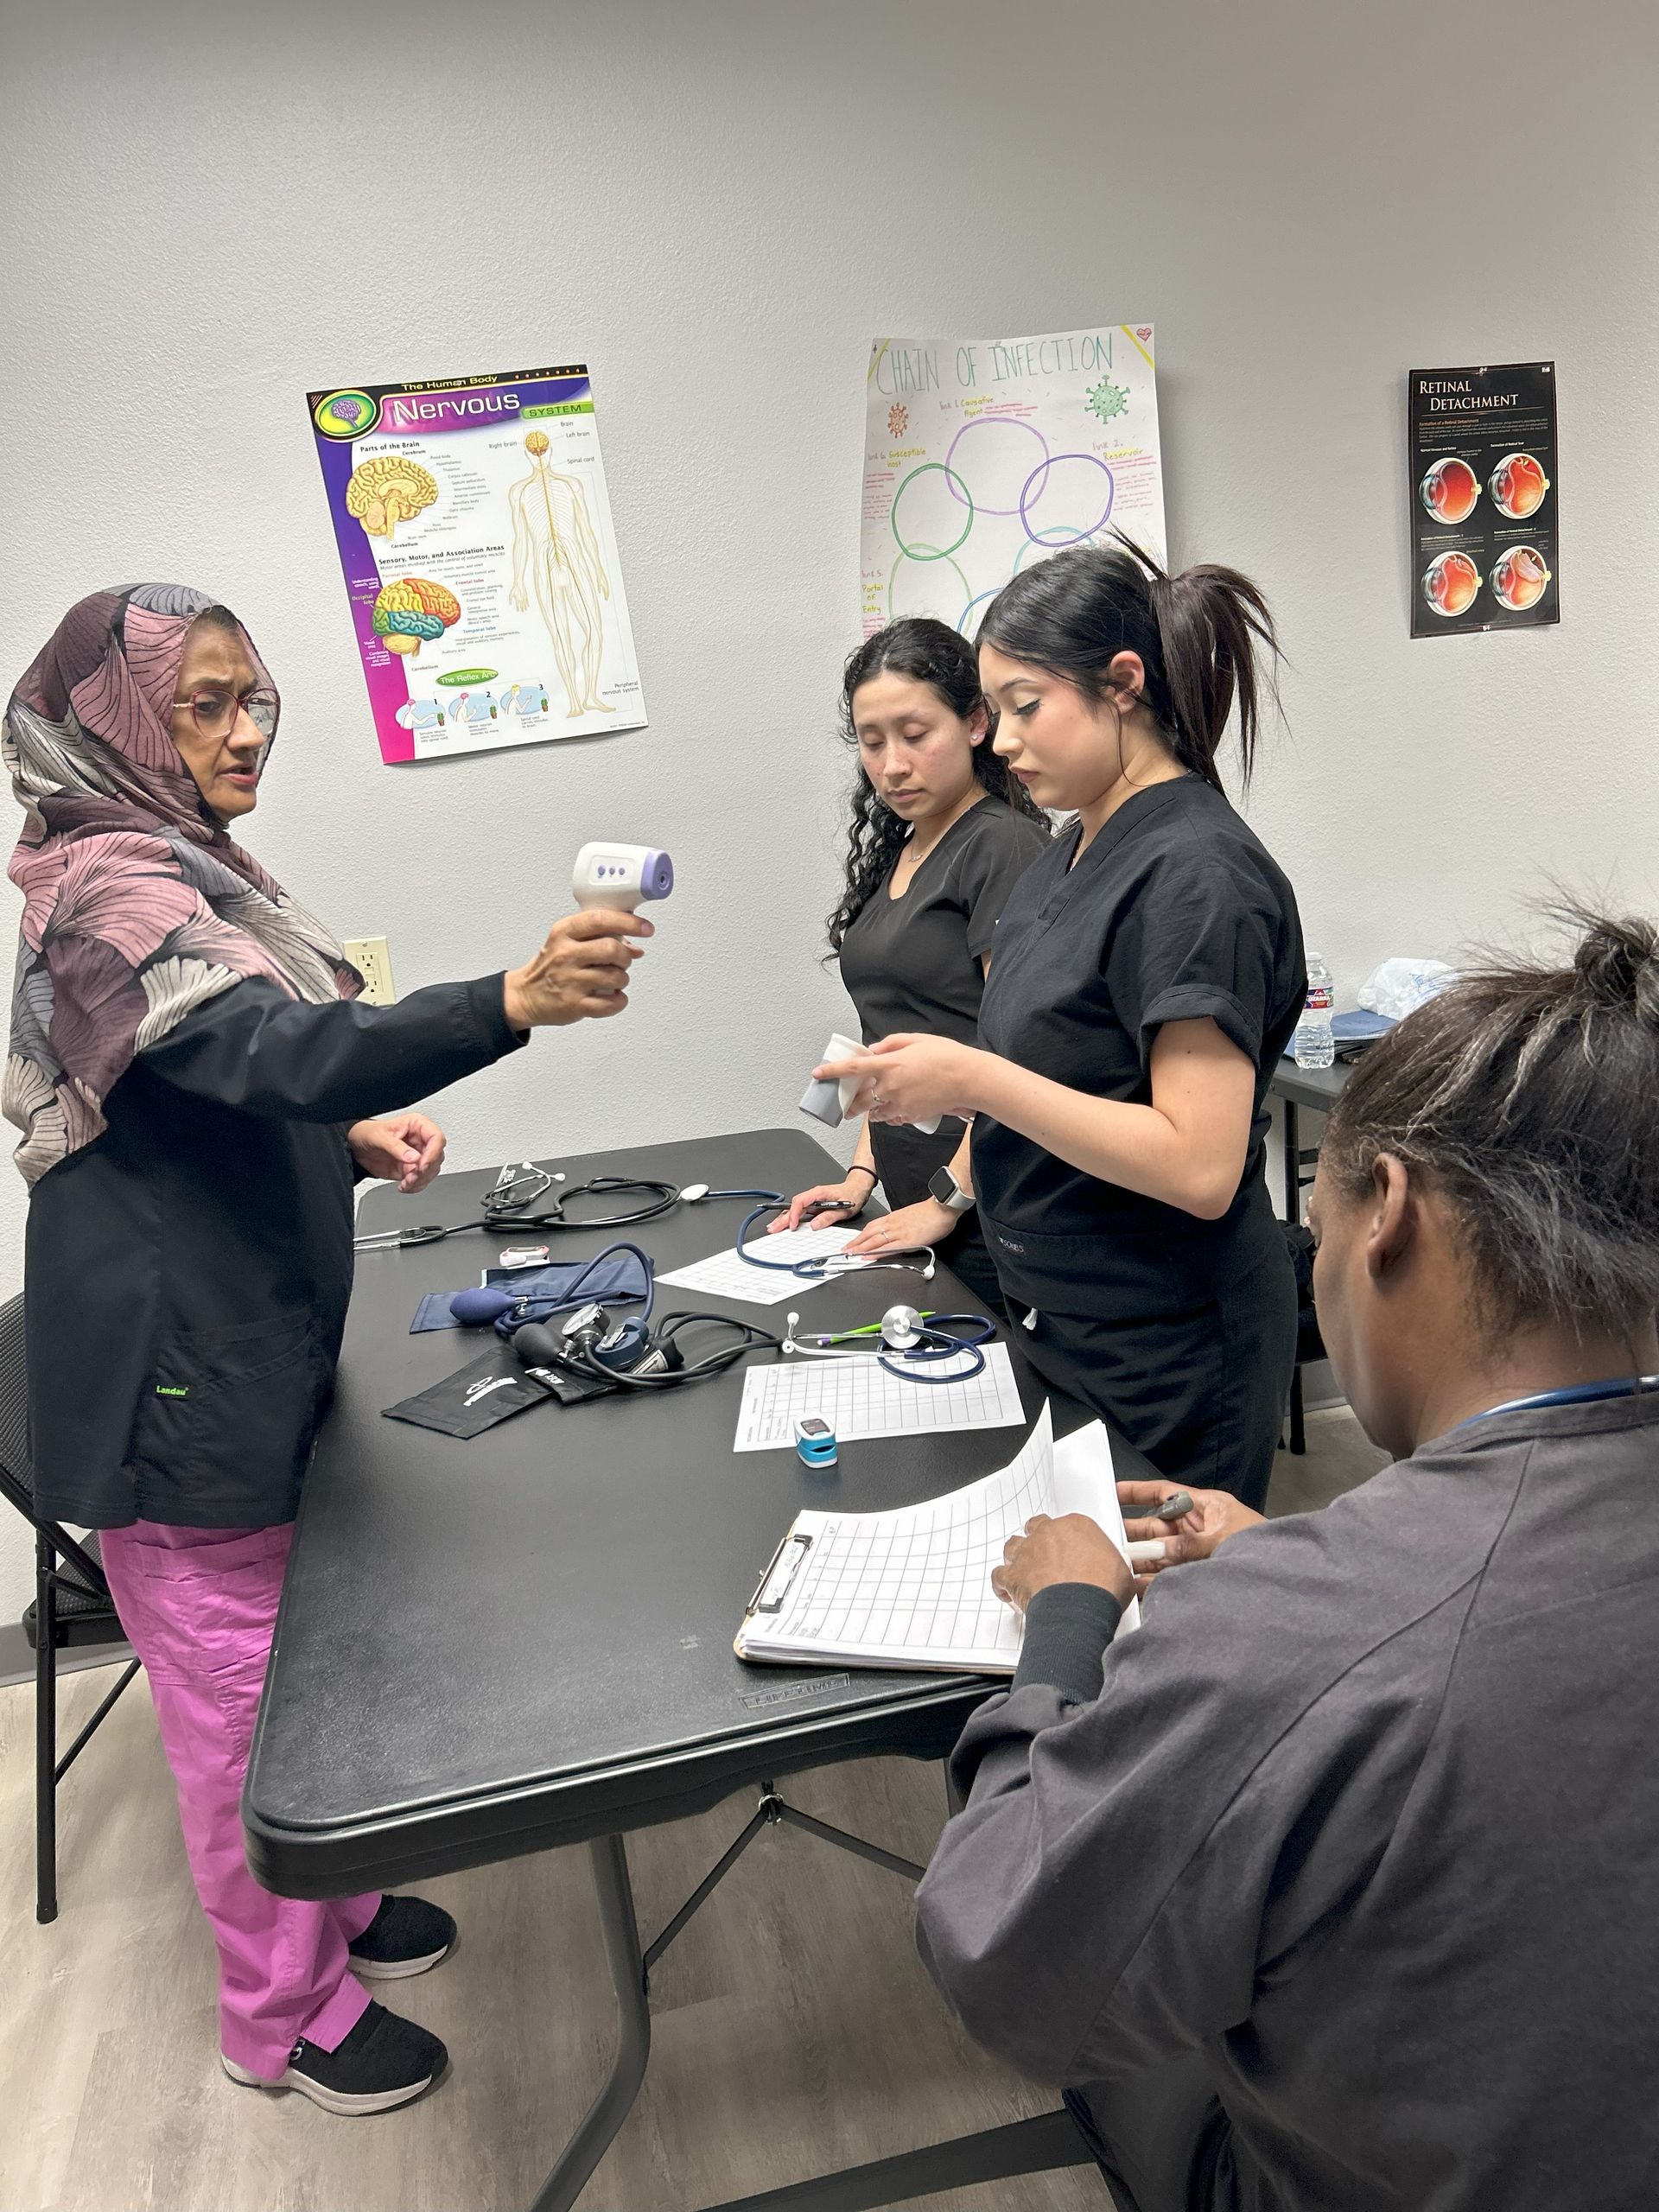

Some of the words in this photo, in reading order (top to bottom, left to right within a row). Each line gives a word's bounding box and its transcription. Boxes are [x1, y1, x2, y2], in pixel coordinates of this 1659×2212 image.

[876, 348, 940, 395] CHAIN
[956, 346, 977, 387] OF
[988, 332, 1113, 382] INFECTION
[426, 379, 467, 390] Human
[470, 374, 499, 385] Body
[1420, 380, 1471, 394] RETINAL
[394, 392, 520, 423] Nervous
[1430, 394, 1519, 411] DETACHMENT
[529, 404, 582, 417] SYSTEM
[359, 444, 378, 453] Parts
[402, 441, 420, 449] Brain
[566, 457, 583, 466] Spinal
[378, 556, 407, 566] Sensory,
[409, 553, 430, 562] Motor,
[446, 547, 484, 557] Association
[441, 676, 454, 685] The
[456, 673, 480, 683] Reflex
[614, 680, 639, 690] Peripheral
